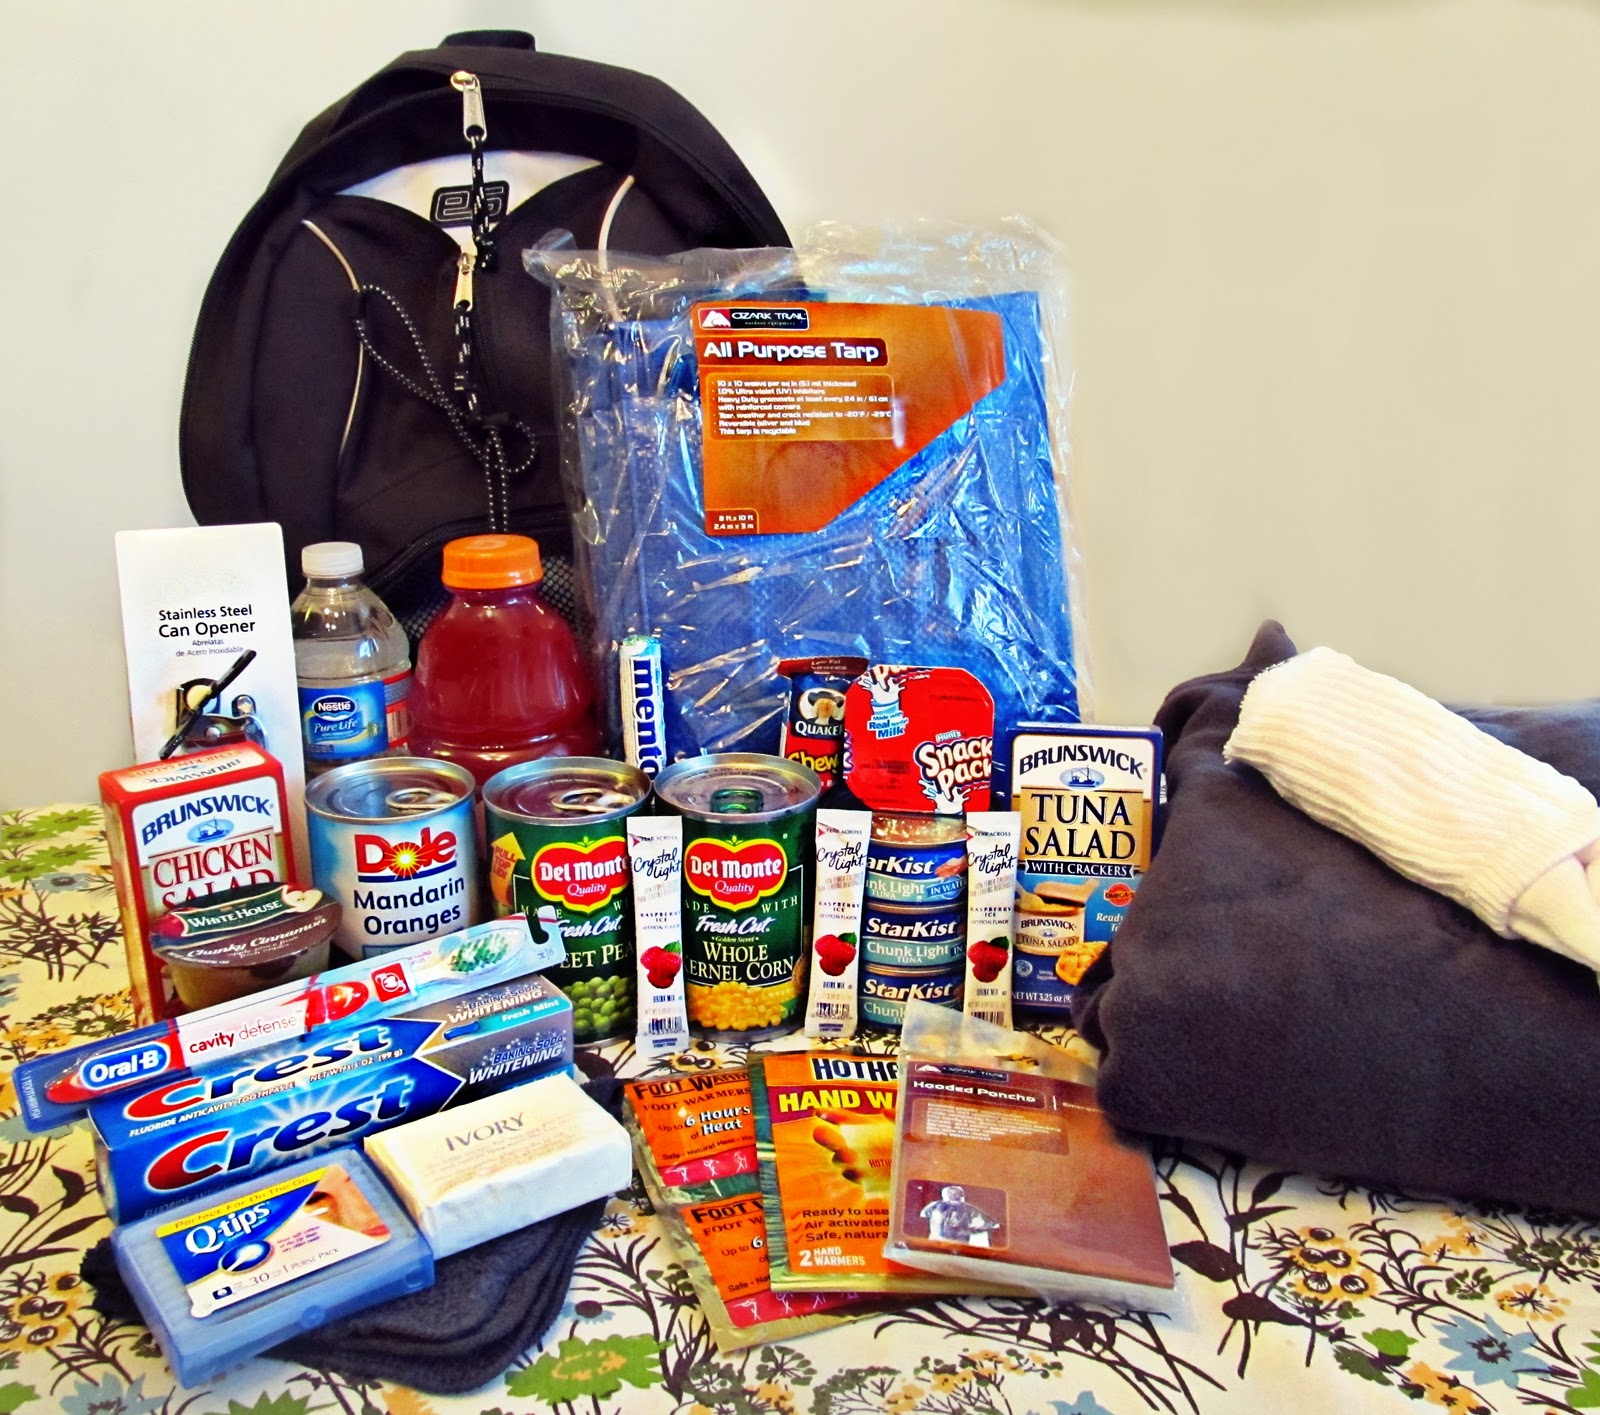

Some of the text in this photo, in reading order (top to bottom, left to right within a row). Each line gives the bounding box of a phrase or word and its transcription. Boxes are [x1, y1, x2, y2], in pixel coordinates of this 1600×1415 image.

[732, 312, 806, 320] OZARK TRAIL
[704, 341, 879, 362] All Purpose Tarp
[761, 428, 796, 436] recyclable
[159, 604, 252, 621] Stainless Steel
[159, 621, 255, 638] Can Opener
[314, 718, 358, 733] Pure Life
[633, 659, 662, 780] mento
[869, 719, 890, 729] Real
[878, 726, 904, 738] Milk
[919, 738, 993, 778] Snack
[1019, 744, 1143, 780] BRUNSWICK
[937, 758, 992, 800] Pack
[142, 794, 272, 846] BRUNSWICK
[1031, 793, 1133, 826] TUNA
[354, 827, 457, 876] Dole
[817, 842, 861, 867] Crystal
[1025, 827, 1136, 860] SALAD
[153, 833, 273, 889] CHICKEN
[634, 847, 677, 877] Crystal
[690, 856, 782, 879] Del Monte
[967, 843, 1010, 871] Crystal
[540, 862, 571, 882] Del
[1032, 862, 1127, 877] WITH CRACKERS
[354, 877, 464, 910] Mandarin
[567, 883, 607, 897] Quality
[715, 880, 755, 894] Quality
[872, 890, 896, 900] TUNA
[890, 879, 925, 897] Light
[930, 886, 941, 895] IN
[761, 896, 798, 914] WITH
[364, 905, 461, 935] Oranges
[696, 915, 738, 935] Fresh
[866, 917, 958, 937] StarKist
[1021, 919, 1075, 931] BRUNSWICK
[187, 942, 248, 958] Chunky
[250, 917, 327, 946] Cinnamon
[1021, 935, 1075, 947] TUNA SALAD
[703, 941, 768, 962] WHOLE
[867, 942, 949, 960] Chunk Light
[747, 956, 794, 981] CORN
[469, 985, 539, 1010] BAKING SODA
[863, 979, 954, 1001] StarKist
[1039, 993, 1053, 1002] 3.25
[448, 990, 543, 1023] WHITENING
[502, 1000, 559, 1022] Fresh Mint
[189, 1016, 297, 1053] cavity defense
[493, 1035, 563, 1065] BAKING SODA
[90, 1050, 159, 1083] Oral-B
[126, 1024, 391, 1119] Crest
[469, 1045, 563, 1085] WHITENING
[129, 1058, 374, 1137] FLUORIDE ANTICAVITY TOOTHPASTE NET OZ
[633, 1080, 685, 1100] FOOT
[643, 1088, 751, 1111] FOOT WARMERS
[914, 1081, 1036, 1103] Hooded Poncho
[779, 1090, 861, 1113] HAND
[658, 1124, 672, 1132] Up
[685, 1115, 696, 1127] 6
[700, 1105, 751, 1122] Hours
[691, 1119, 743, 1140] of Heat
[147, 1078, 411, 1190] Crest
[445, 1112, 524, 1151] IVORY
[662, 1138, 735, 1161] Safe Natural Heat
[174, 1177, 308, 1229] Perfect For On The Go
[690, 1202, 748, 1224] FOOT
[803, 1208, 889, 1218] Ready to use
[185, 1202, 270, 1257] Q-tips
[703, 1221, 743, 1236] FOOT
[804, 1219, 890, 1230] Air activated
[721, 1236, 764, 1257] Up to 6
[806, 1231, 841, 1242] Safe,
[799, 1250, 813, 1267] 2
[814, 1246, 842, 1255] HAND
[814, 1255, 866, 1266] WARMERS
[250, 1272, 270, 1286] 30
[291, 1256, 316, 1270] PURSE
[318, 1248, 339, 1259] PACK
[728, 1282, 749, 1293] Safe
